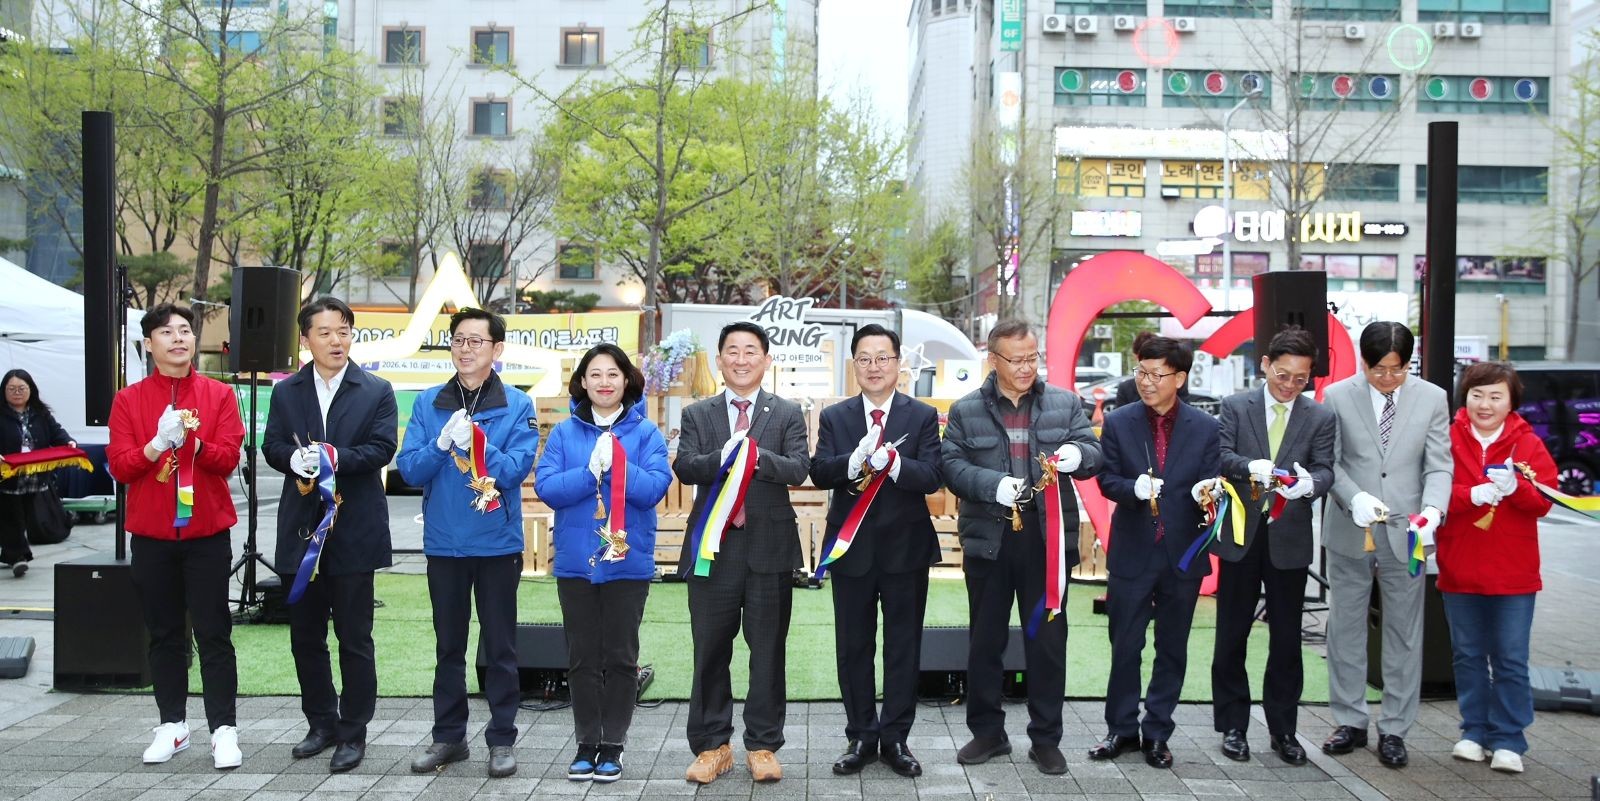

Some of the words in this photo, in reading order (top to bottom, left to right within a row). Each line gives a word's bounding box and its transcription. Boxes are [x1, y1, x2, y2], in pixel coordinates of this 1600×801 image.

[1003, 28, 1018, 38] 6F
[1112, 163, 1142, 179] 코인
[1234, 209, 1286, 242] 타이
[750, 297, 811, 322] ART
[765, 326, 830, 348] RING
[789, 353, 823, 364] 아트페어
